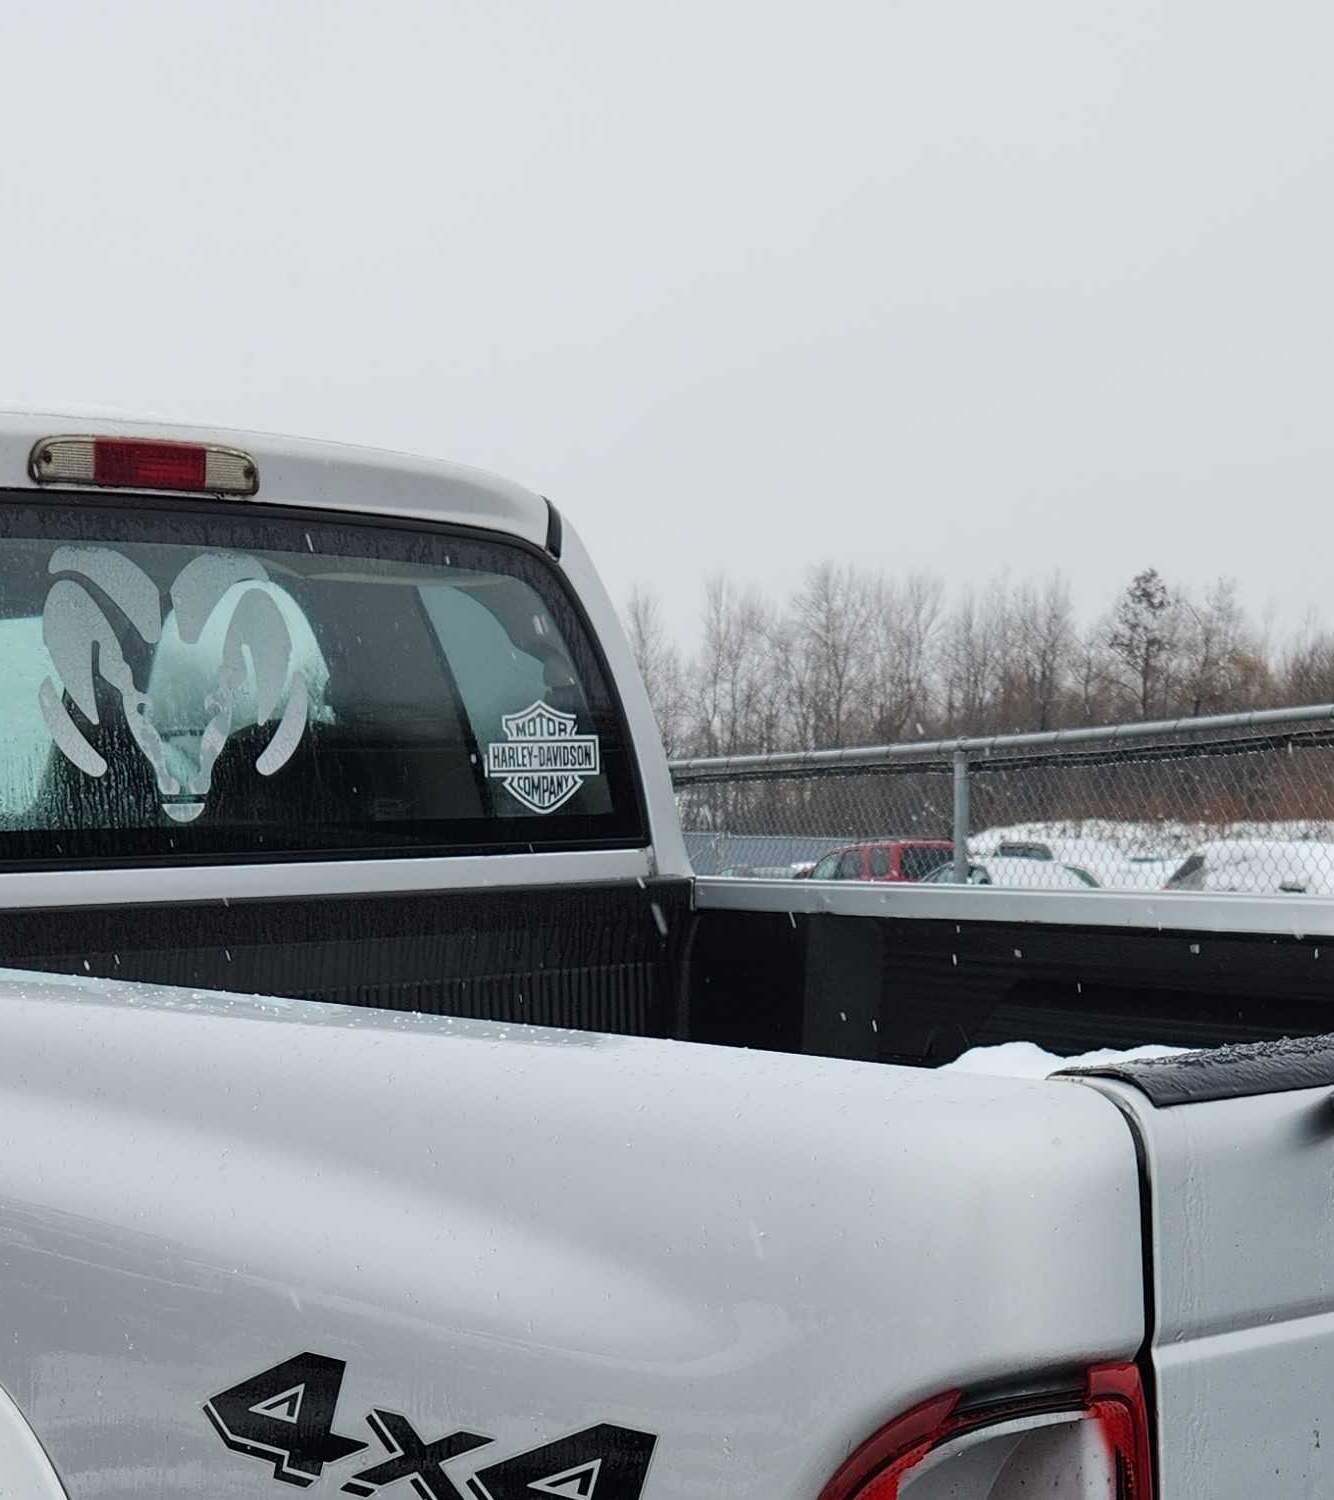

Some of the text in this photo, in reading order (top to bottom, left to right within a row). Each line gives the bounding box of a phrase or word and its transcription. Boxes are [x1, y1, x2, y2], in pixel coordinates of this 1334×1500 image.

[515, 715, 568, 737] MOTOR
[492, 744, 592, 768] HARLEY-DAVIDSON
[517, 774, 570, 806] COMPANY
